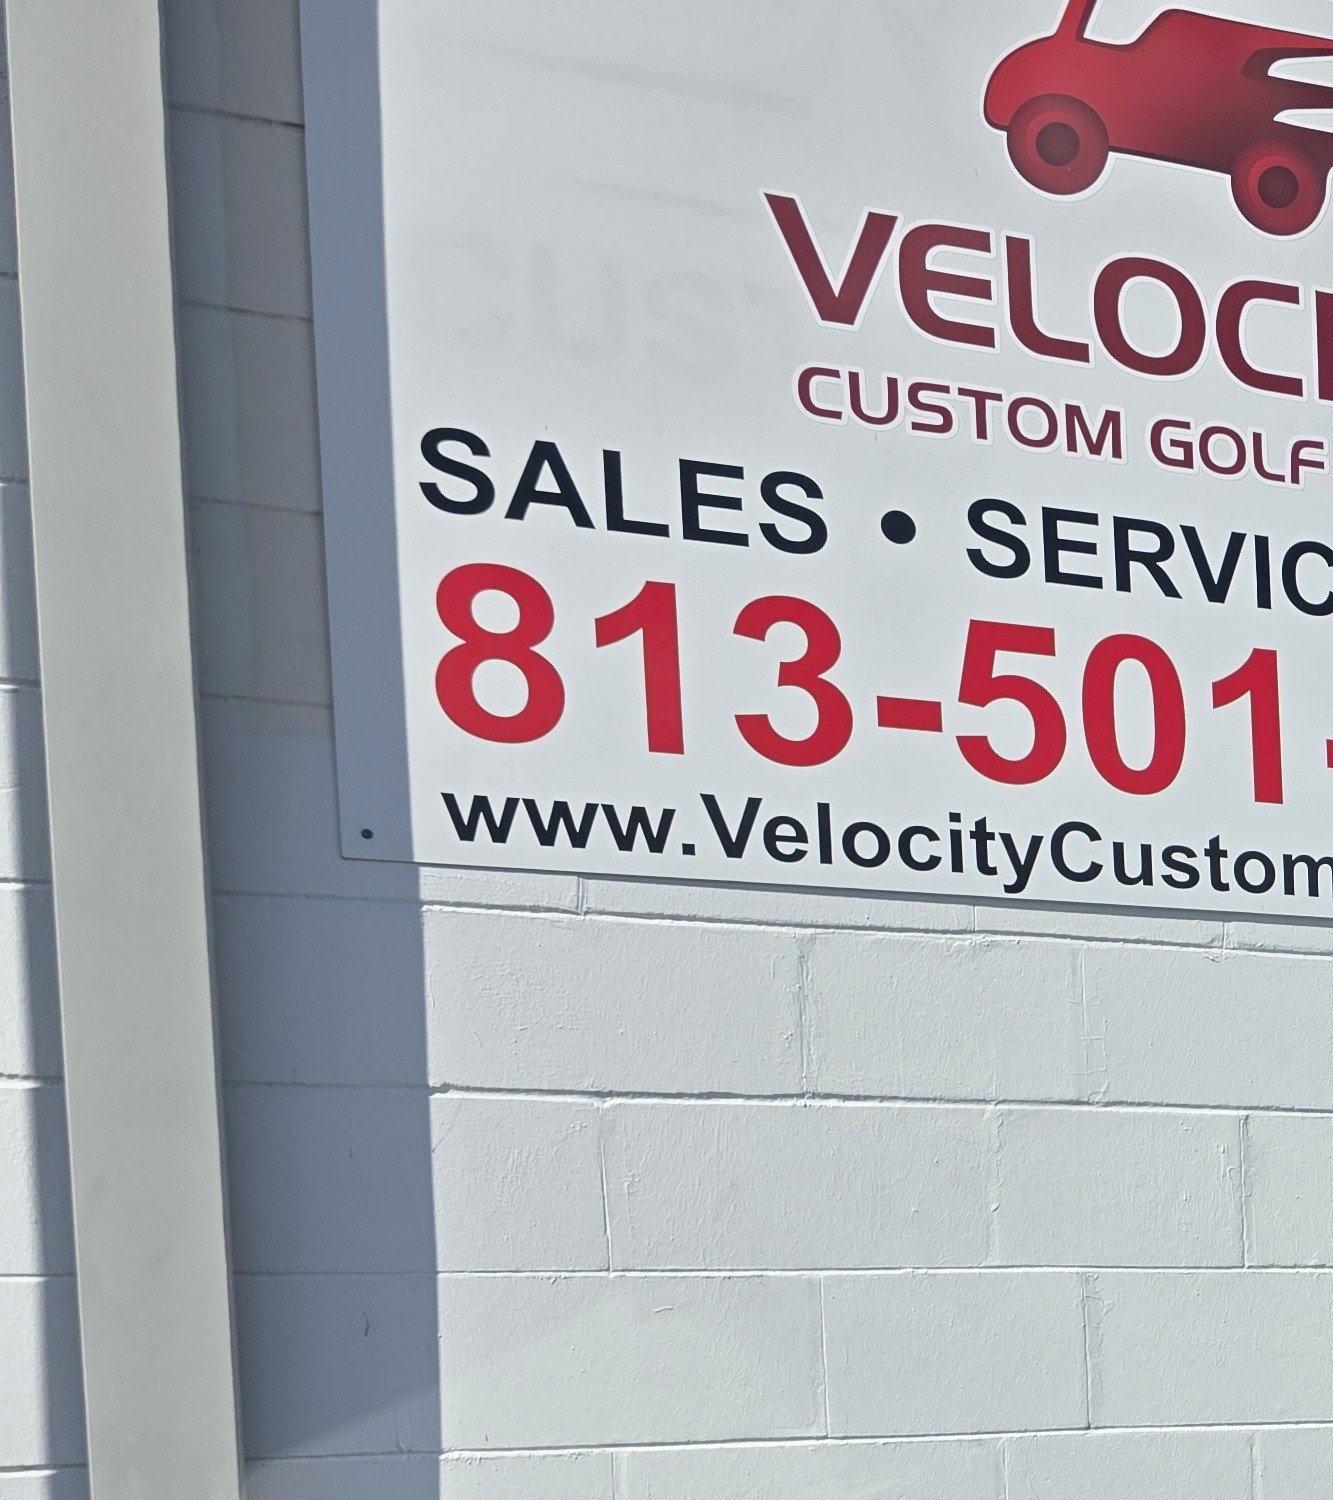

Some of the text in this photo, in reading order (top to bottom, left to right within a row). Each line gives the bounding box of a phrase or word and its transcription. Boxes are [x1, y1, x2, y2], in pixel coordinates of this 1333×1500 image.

[798, 368, 1121, 459] CUSTOM
[1151, 420, 1325, 486] GOLF
[419, 427, 828, 555] SALES
